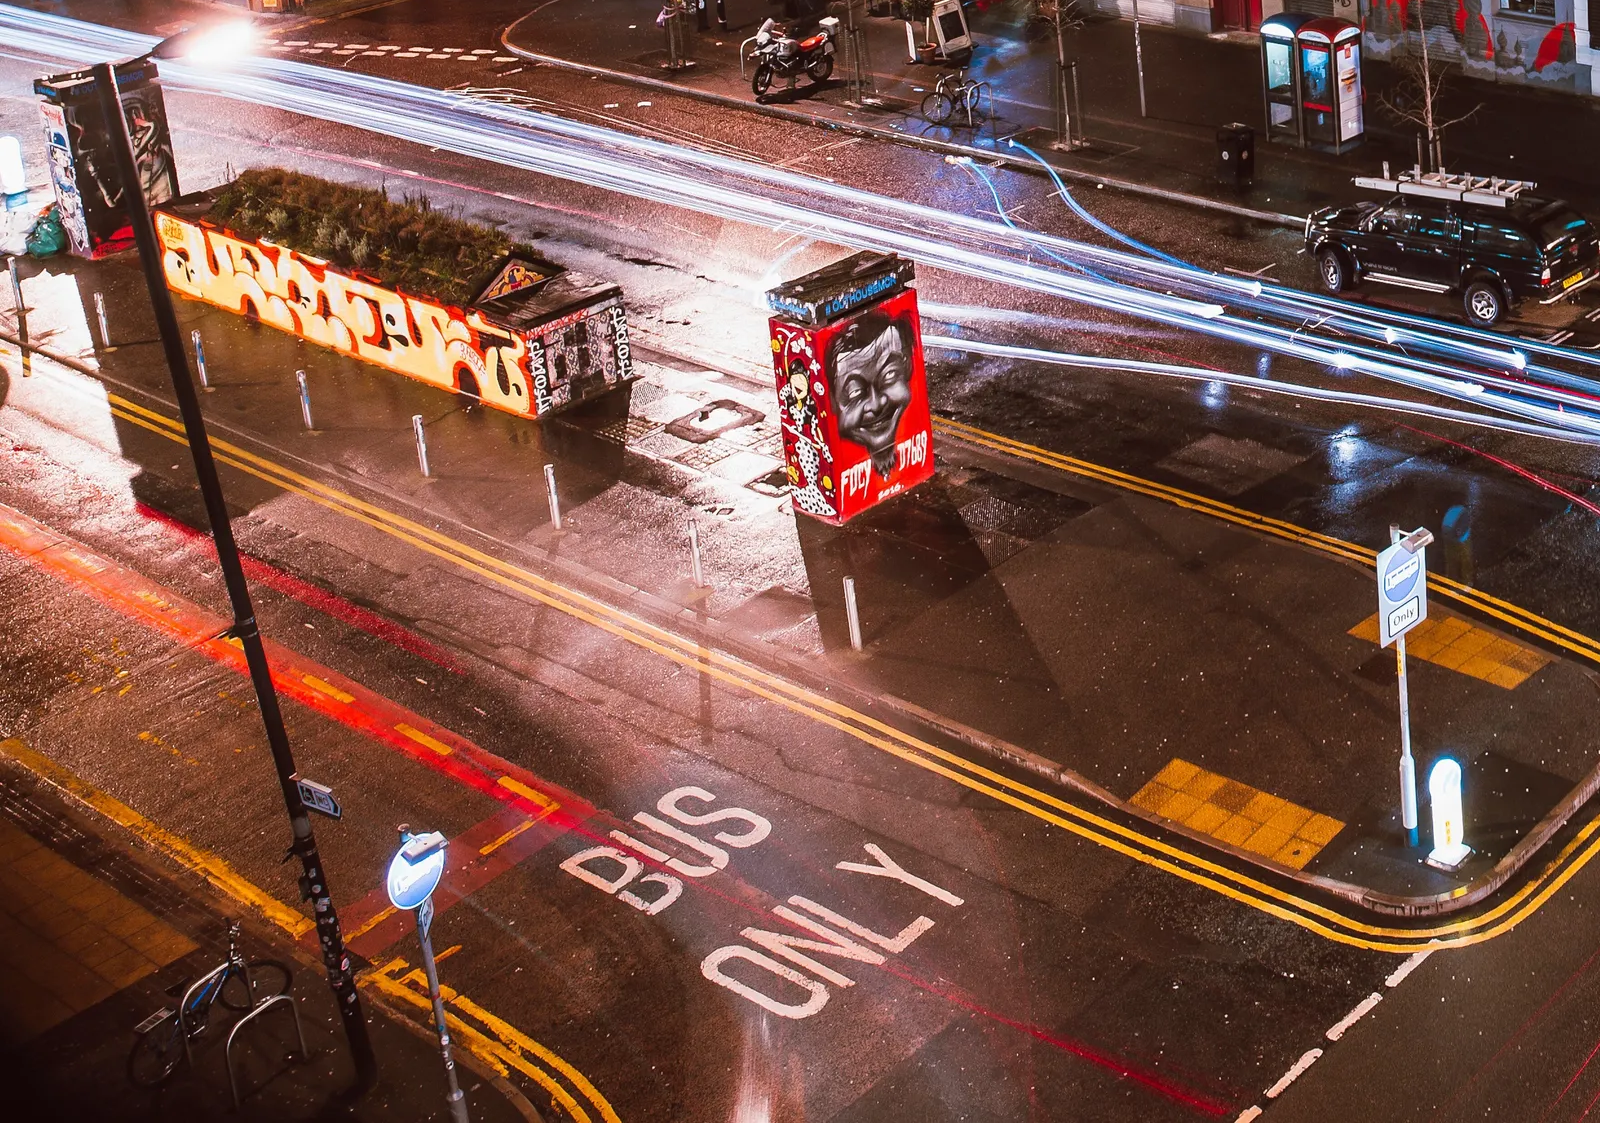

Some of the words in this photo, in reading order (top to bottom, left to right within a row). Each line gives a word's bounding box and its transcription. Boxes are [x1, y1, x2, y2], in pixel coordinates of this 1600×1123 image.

[1393, 607, 1415, 626] Only
[559, 785, 772, 915] BUS
[700, 842, 965, 1019] ONLY
